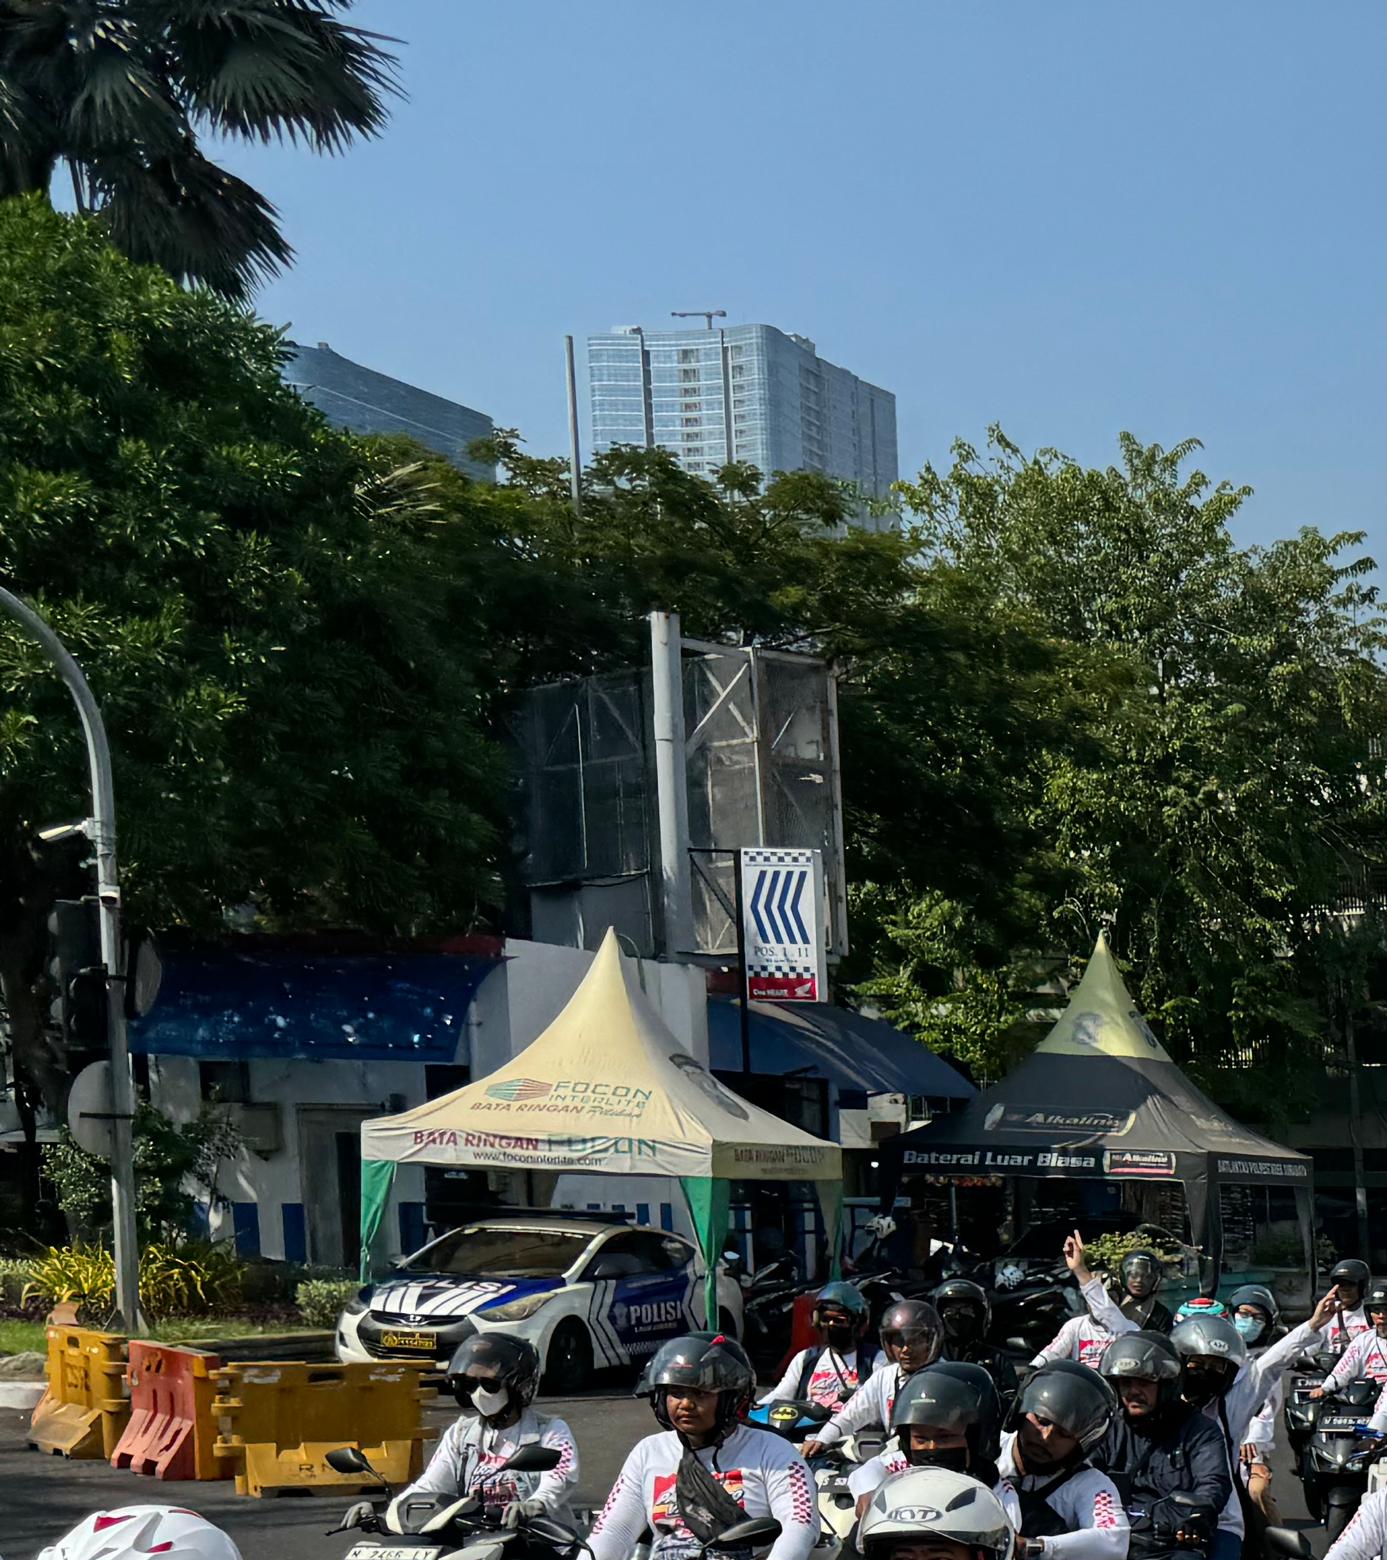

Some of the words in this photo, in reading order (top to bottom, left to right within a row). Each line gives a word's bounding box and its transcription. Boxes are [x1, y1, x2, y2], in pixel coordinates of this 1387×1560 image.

[554, 1081, 652, 1100] FOCON
[470, 1102, 511, 1112] BATA
[516, 1103, 584, 1114] RINGAN
[413, 1131, 459, 1147] BATA
[464, 1132, 539, 1151] RINGAN
[904, 1150, 980, 1165] Baterai
[985, 1151, 1033, 1166] Luar
[1037, 1152, 1095, 1168] Biasa
[630, 1301, 682, 1325] POLISI
